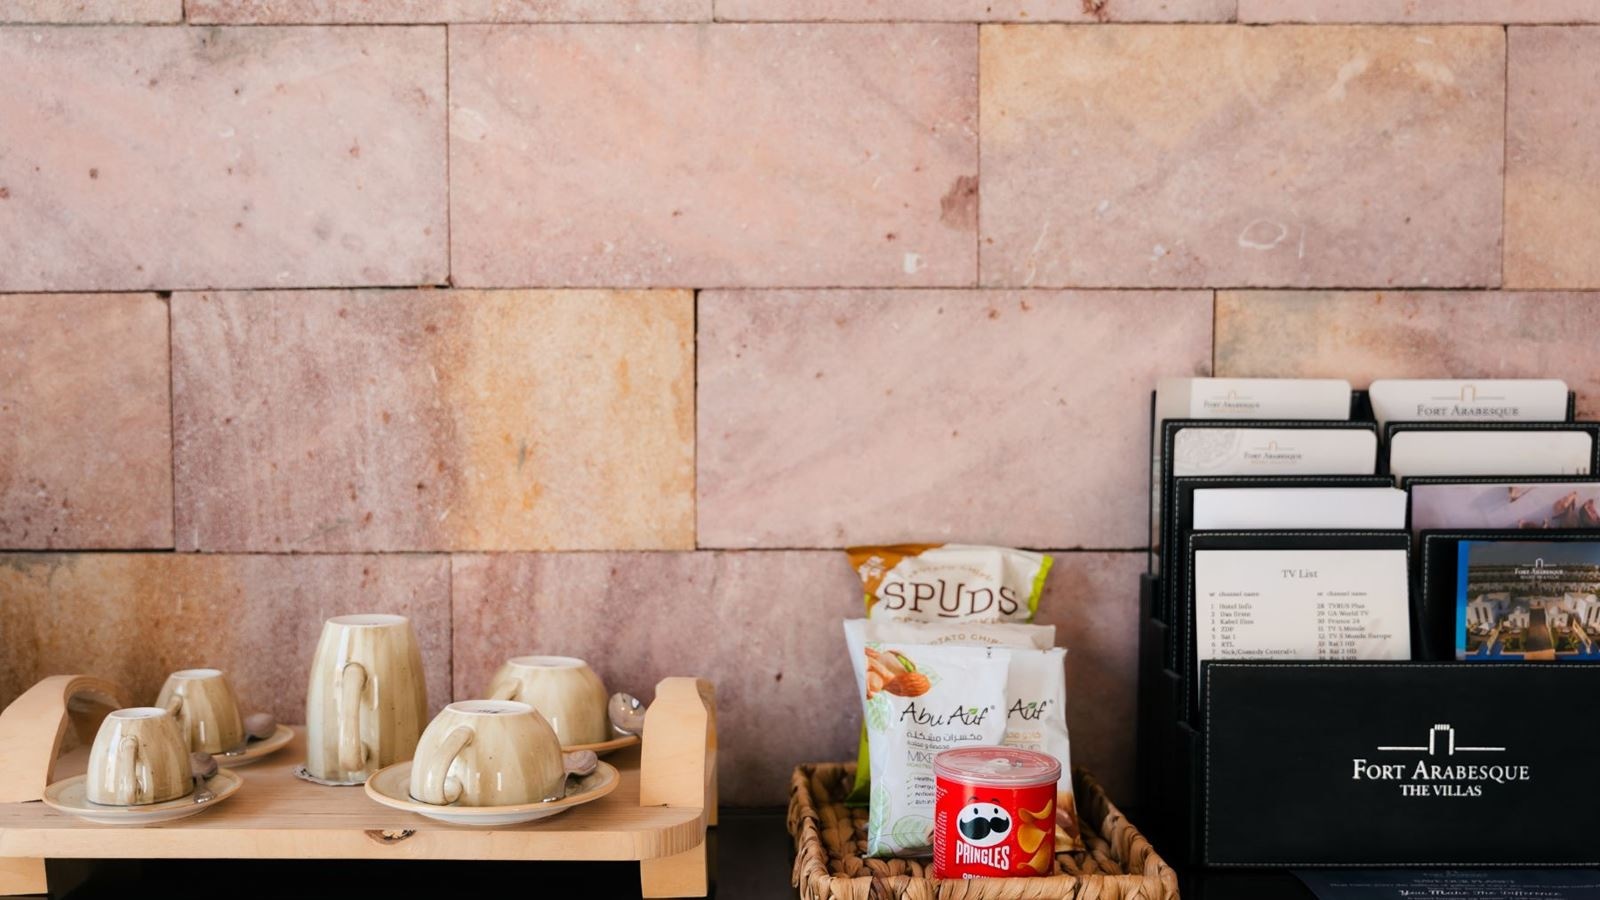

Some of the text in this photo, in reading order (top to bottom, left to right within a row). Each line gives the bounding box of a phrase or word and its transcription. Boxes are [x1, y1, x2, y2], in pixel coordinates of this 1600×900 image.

[1416, 404, 1520, 418] FORT ARABESQUE
[1282, 569, 1318, 578] TV List
[884, 579, 1018, 618] SPUDS
[900, 702, 989, 727] Abu Auf
[1008, 698, 1047, 721] Auf
[906, 750, 933, 763] MIXE
[1352, 759, 1530, 784] FORT ARABESQUE
[1400, 785, 1482, 796] THE VILLAS
[956, 840, 1010, 870] PRINGLES
